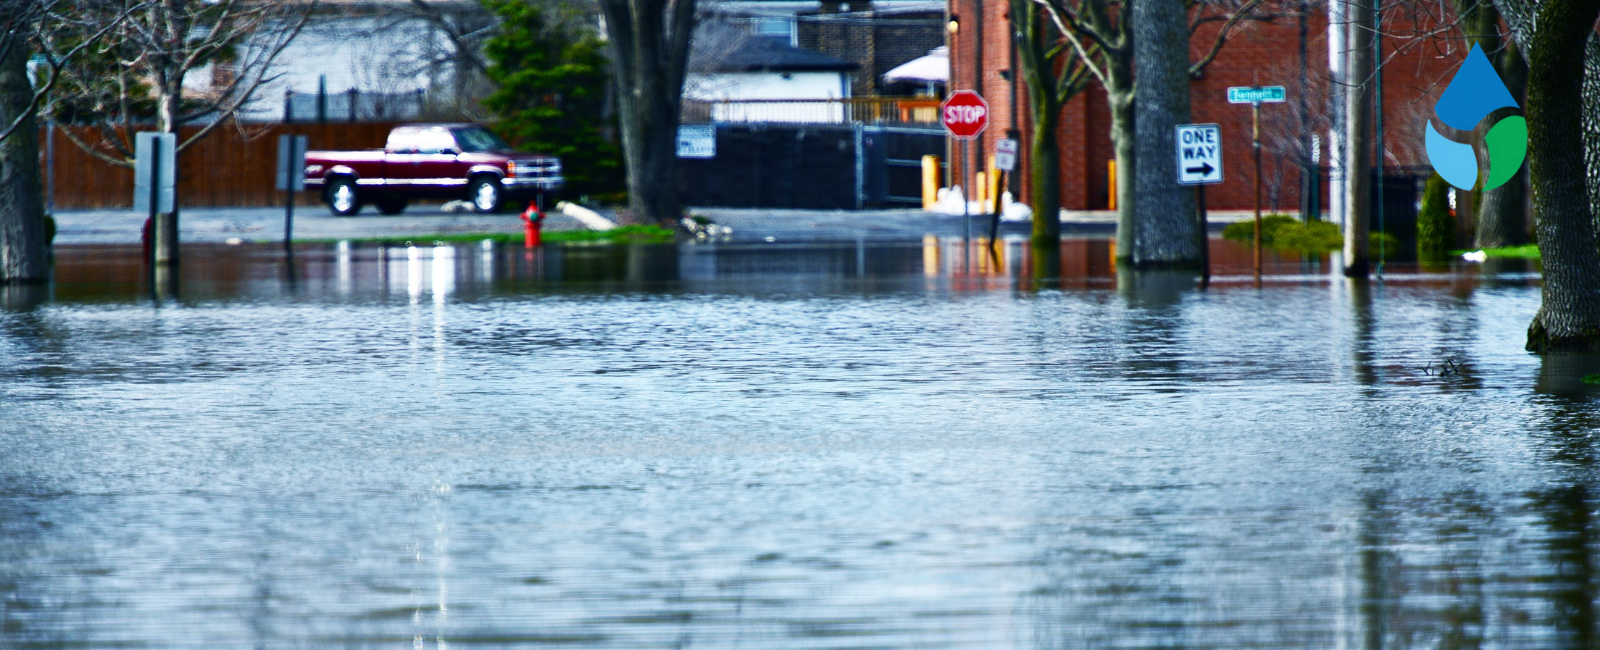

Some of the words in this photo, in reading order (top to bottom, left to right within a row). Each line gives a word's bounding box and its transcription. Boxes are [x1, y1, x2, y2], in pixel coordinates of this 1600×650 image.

[945, 105, 985, 123] STOP
[1182, 130, 1215, 144] ONE
[1183, 146, 1217, 159] WAY
